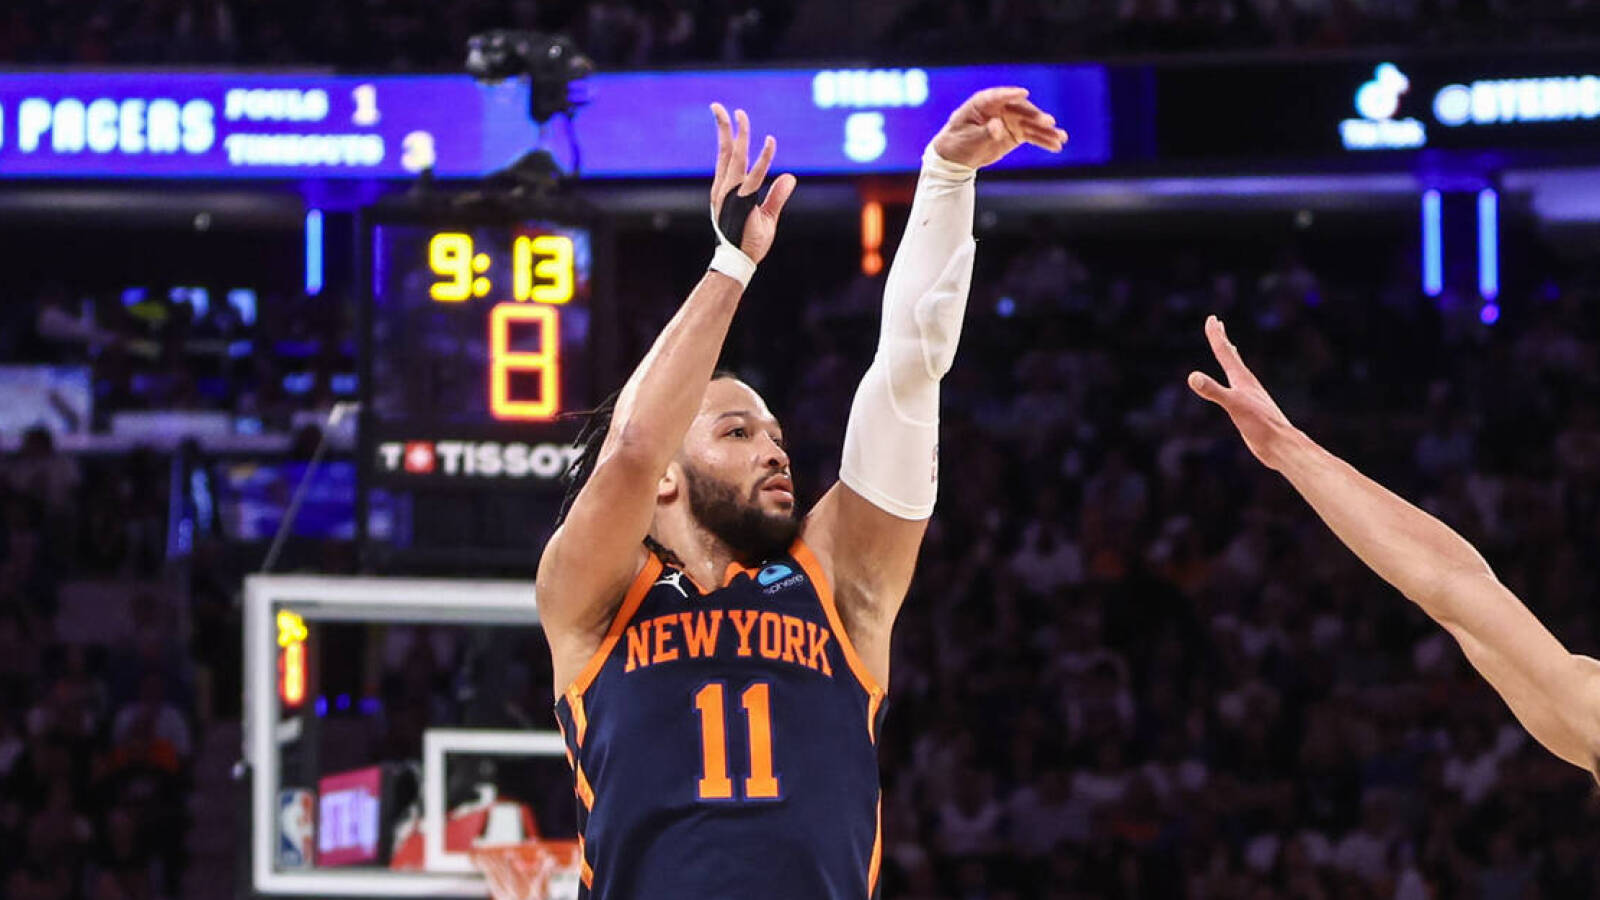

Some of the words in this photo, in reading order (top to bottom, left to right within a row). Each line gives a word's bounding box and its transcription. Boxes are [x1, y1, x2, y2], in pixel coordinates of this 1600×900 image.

[19, 98, 215, 154] PACERS
[352, 84, 380, 125] 1
[844, 112, 886, 162] 5
[488, 302, 561, 422] 8
[762, 573, 805, 596] sphere
[624, 609, 723, 674] NEW
[728, 609, 833, 678] YORK
[693, 681, 781, 801] 11
